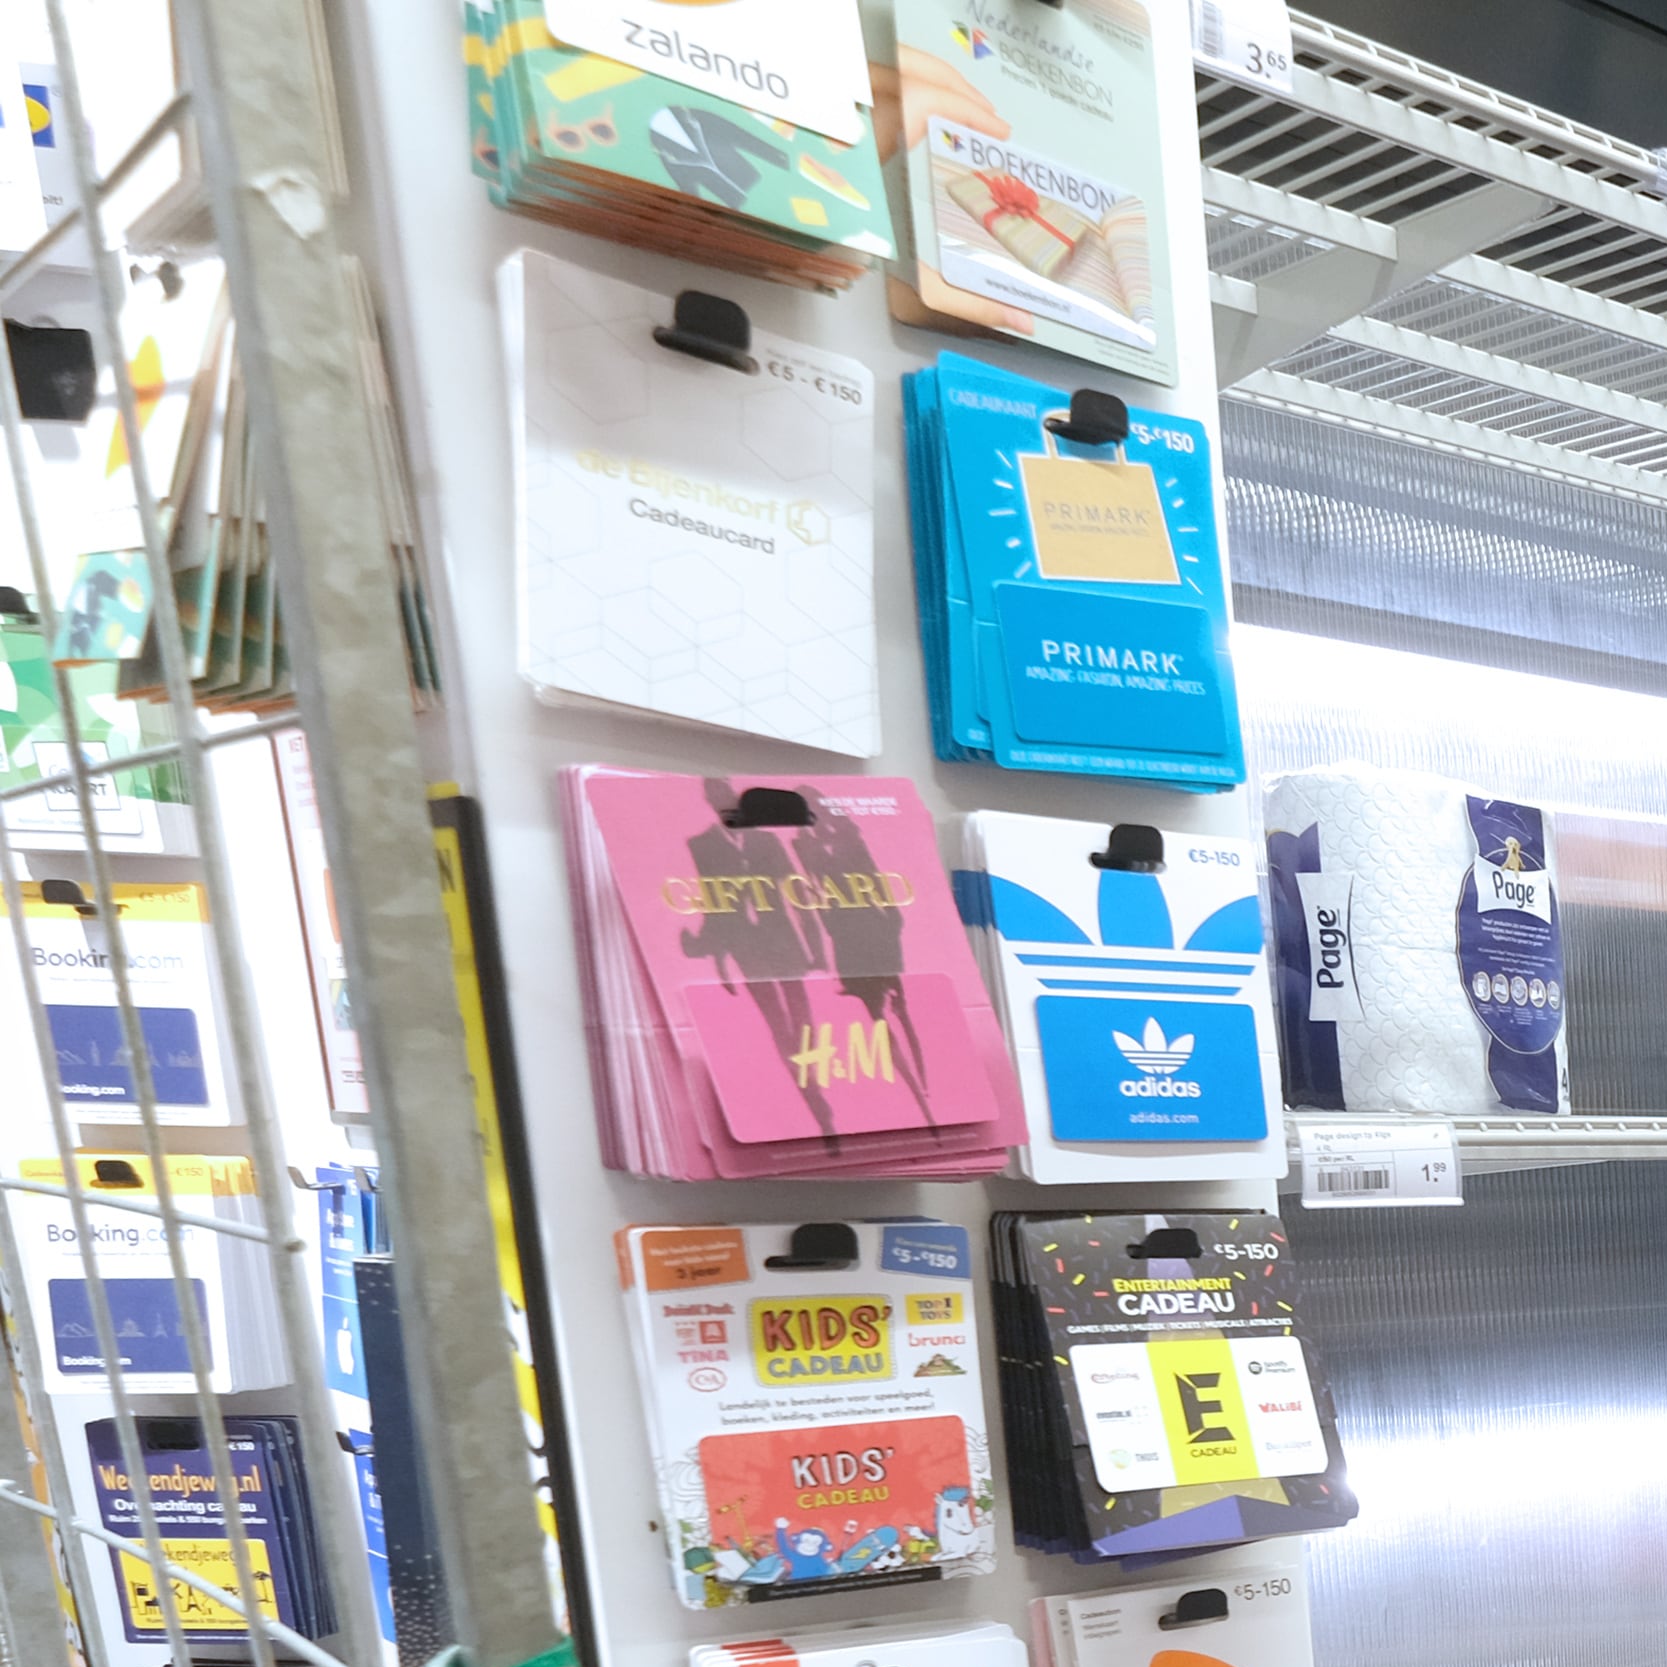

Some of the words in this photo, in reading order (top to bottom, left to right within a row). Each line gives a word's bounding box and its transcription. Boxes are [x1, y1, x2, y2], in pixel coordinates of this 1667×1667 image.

[621, 16, 790, 101] zalando
[1246, 42, 1288, 79] 3.65
[999, 41, 1113, 108] BOEKENBON
[970, 138, 1117, 214] BOEKENBON
[628, 497, 776, 555] Cadeaucard
[1043, 500, 1150, 526] PRIMARK
[1041, 638, 1182, 676] PRIMARK
[1188, 848, 1241, 868] €5-150
[661, 873, 777, 915] GIFT
[782, 871, 915, 911] CARD
[1491, 870, 1536, 910] Page
[1315, 906, 1348, 989] Page
[789, 1018, 895, 1089] H&M
[60, 1084, 126, 1097] ooking.com
[1119, 1075, 1203, 1099] adidas
[1129, 1112, 1200, 1125] adidas.com
[1420, 1161, 1447, 1183] 1.99
[1213, 1243, 1280, 1261] €5-150
[1111, 1276, 1233, 1294] ENTERTAINMENT
[1116, 1291, 1236, 1317] CADEAU
[766, 1351, 885, 1380] CADEAU
[1189, 1446, 1237, 1459] CADEAU
[796, 1485, 890, 1510] CADEAU
[1233, 1577, 1293, 1602] €5-150
